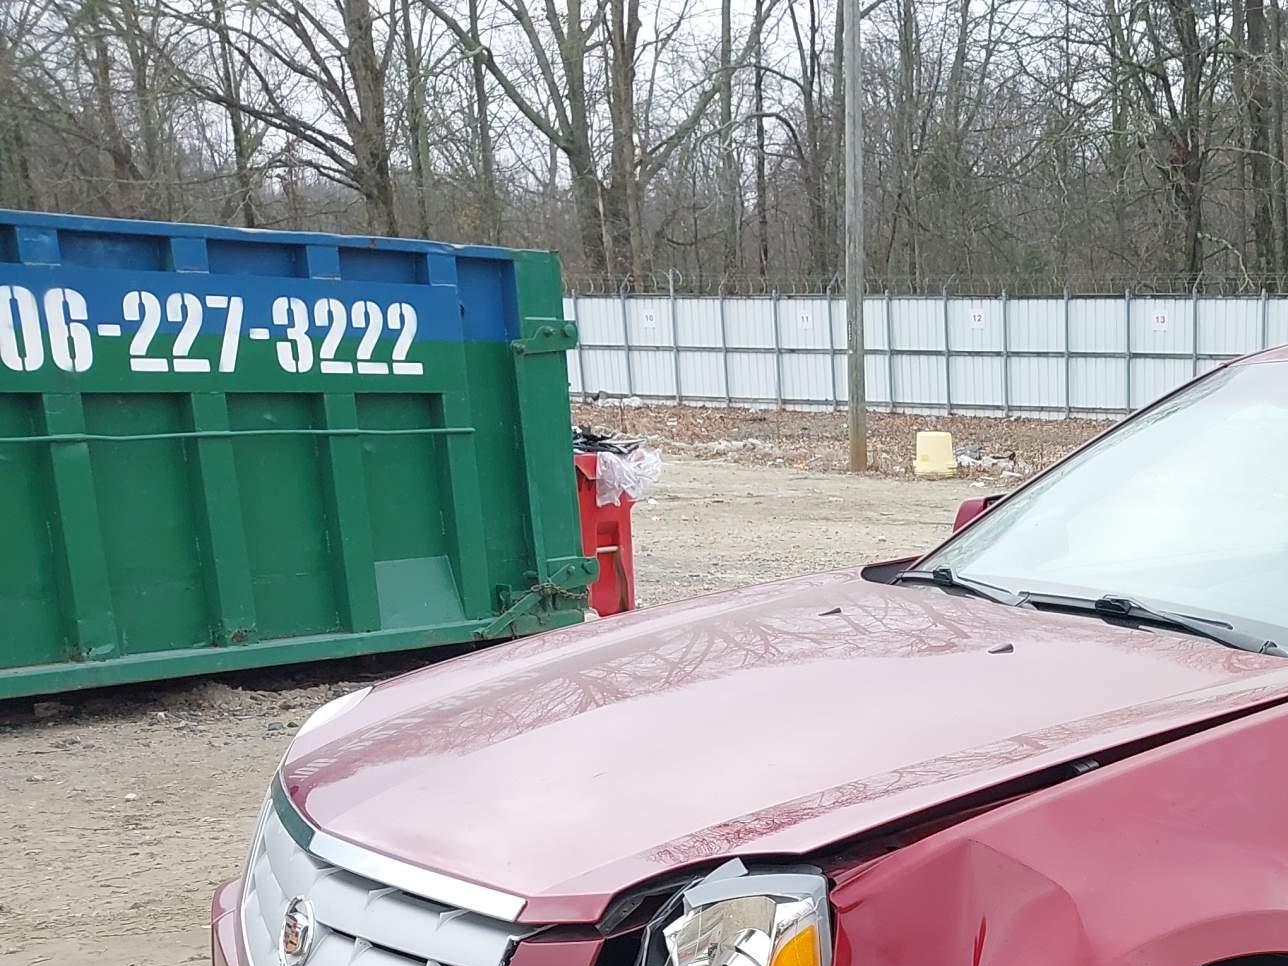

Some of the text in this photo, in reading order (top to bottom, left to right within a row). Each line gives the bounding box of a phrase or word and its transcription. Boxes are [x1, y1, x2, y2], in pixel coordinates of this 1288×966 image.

[973, 314, 982, 322] 12
[1155, 316, 1166, 324] 13
[0, 285, 424, 374] 06-227-3222
